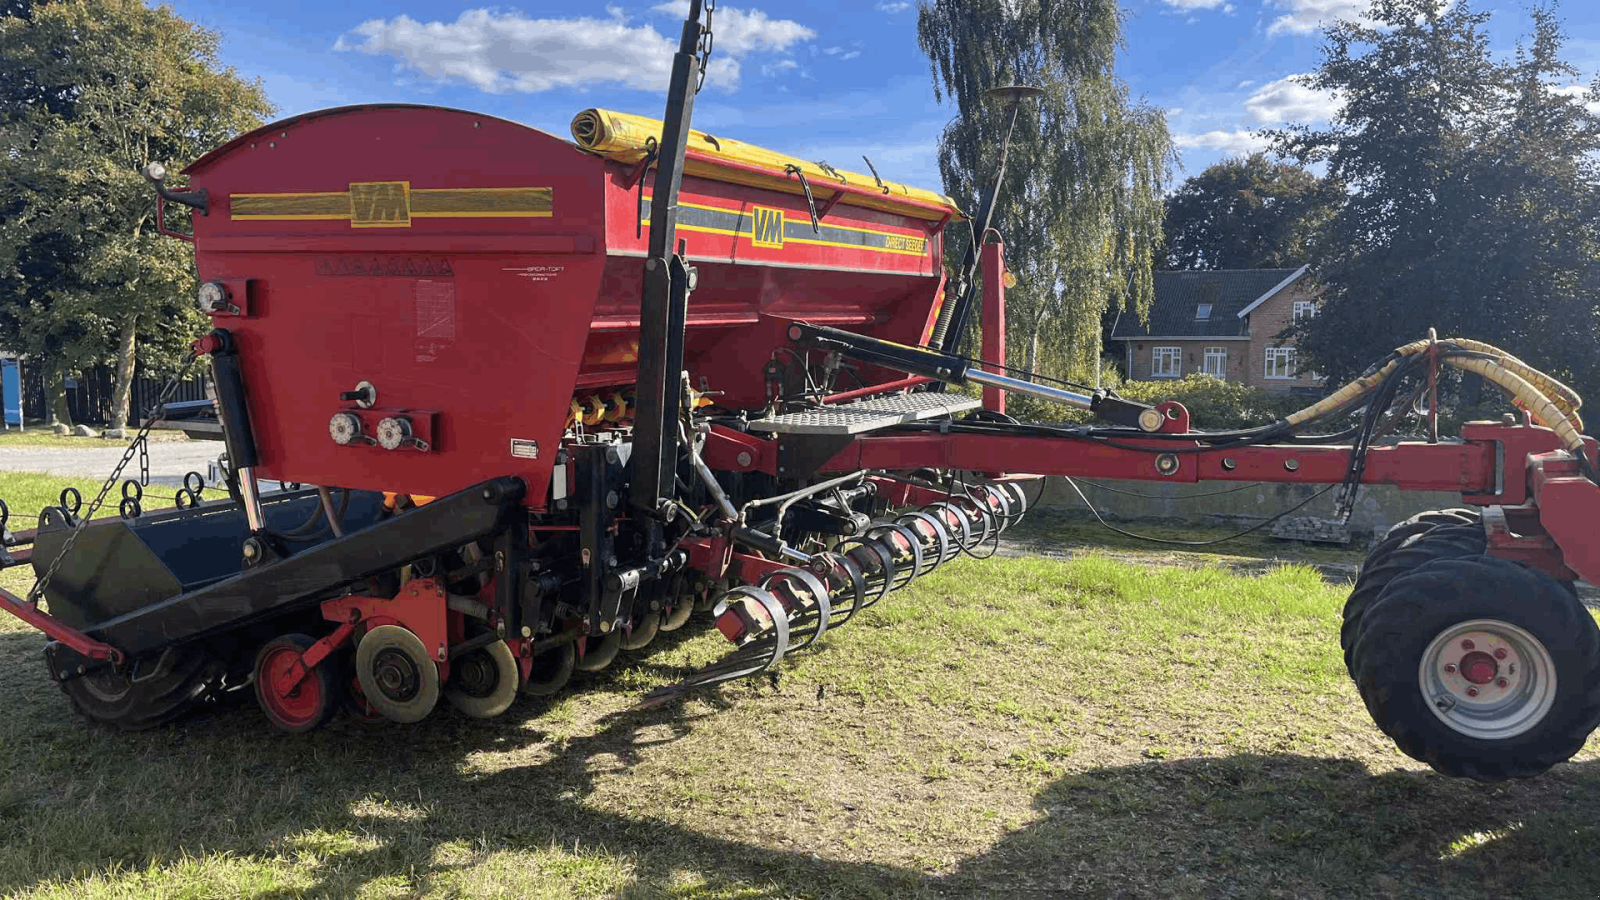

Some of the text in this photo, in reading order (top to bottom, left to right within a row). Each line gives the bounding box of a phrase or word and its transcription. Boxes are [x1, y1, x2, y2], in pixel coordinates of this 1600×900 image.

[351, 184, 408, 221] VM
[753, 207, 783, 244] VM
[885, 235, 905, 251] DIRECT
